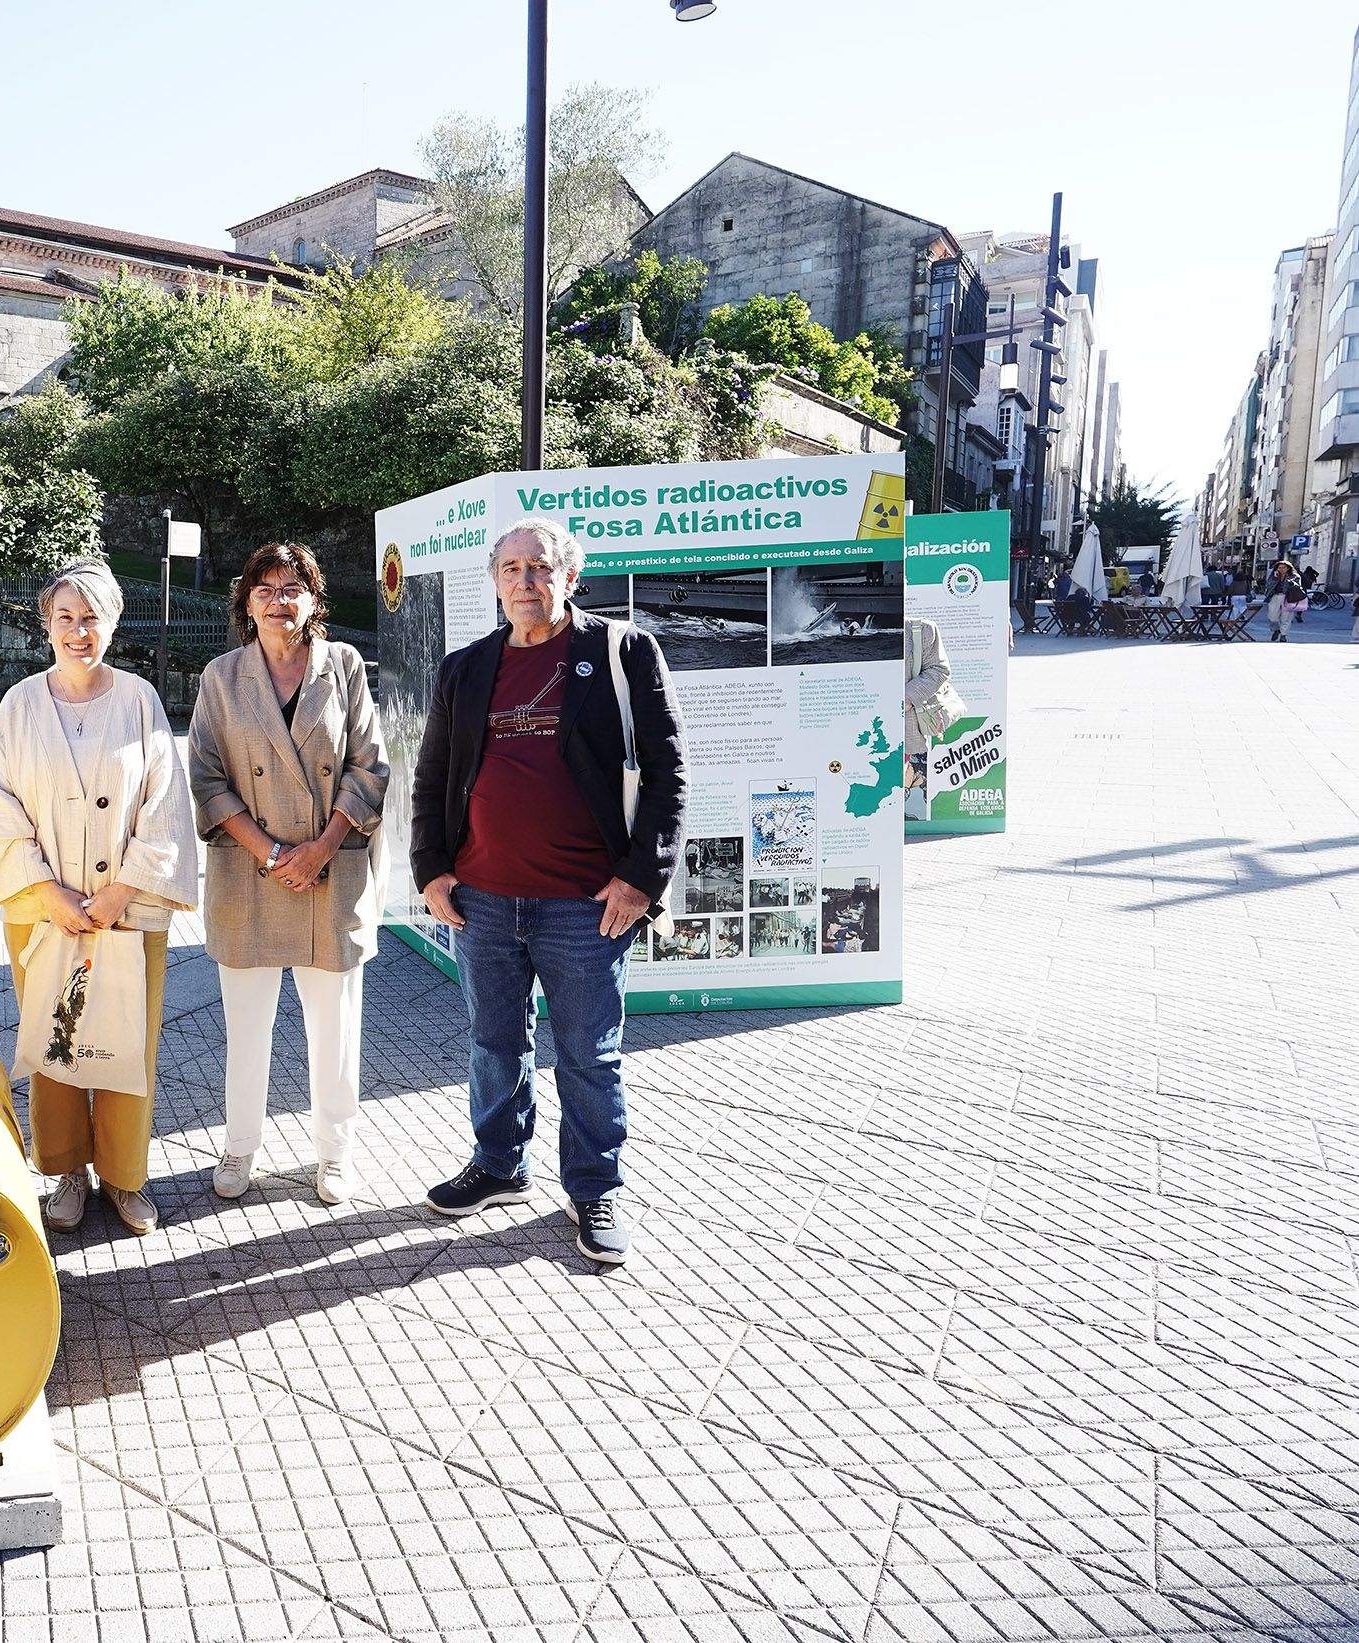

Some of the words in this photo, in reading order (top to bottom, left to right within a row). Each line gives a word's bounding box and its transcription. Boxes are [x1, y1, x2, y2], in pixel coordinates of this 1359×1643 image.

[517, 484, 648, 511] Vertidos
[657, 475, 848, 505] radioactivos
[448, 507, 455, 524] e
[458, 499, 487, 521] Xove
[568, 516, 643, 539] Fosa
[654, 507, 802, 535] Atlántica
[410, 541, 427, 558] non
[429, 533, 442, 555] foi
[444, 527, 487, 552] nuclear
[583, 560, 606, 569] ada,
[626, 556, 668, 568] prestixio
[670, 556, 682, 564] de
[704, 552, 751, 562] concibido
[761, 549, 811, 560] executado
[813, 547, 842, 557] desde
[844, 546, 874, 555] Galiza
[1296, 538, 1306, 546] P
[934, 724, 1003, 774] salvemos
[949, 772, 960, 786] o
[960, 748, 1000, 780] Miño
[960, 788, 1004, 802] ADEGA
